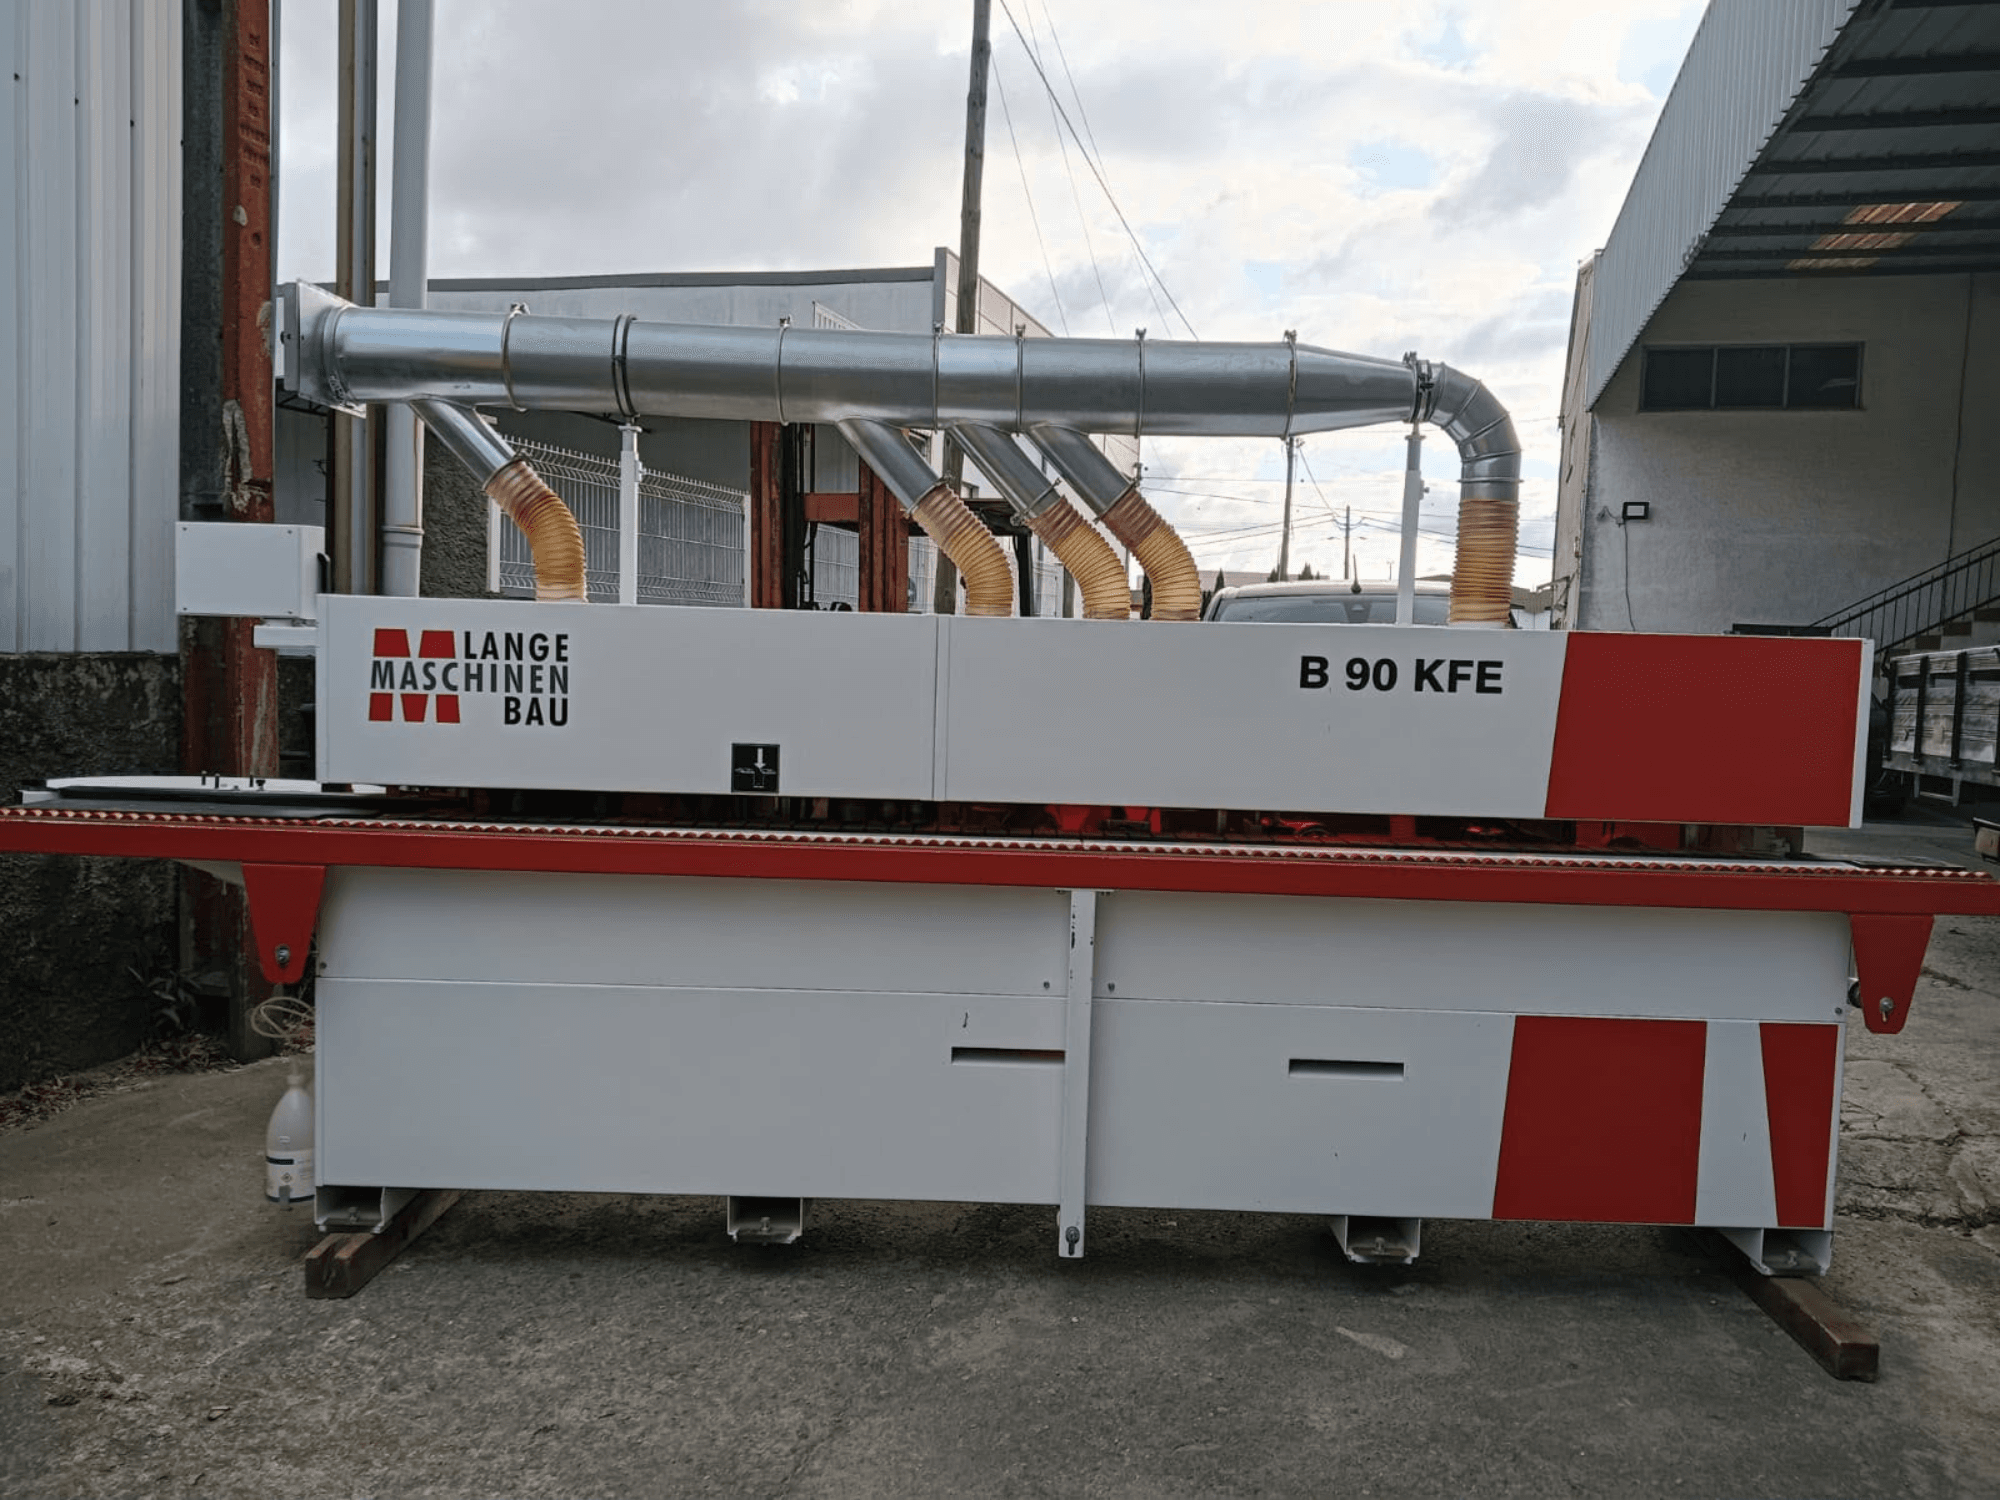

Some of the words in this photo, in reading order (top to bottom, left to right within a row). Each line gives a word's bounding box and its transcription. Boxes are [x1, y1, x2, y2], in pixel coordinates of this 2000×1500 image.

[464, 630, 569, 663] LANGE
[370, 660, 569, 695] MASCHINEN
[1299, 655, 1330, 690] B
[1345, 657, 1398, 692] 90
[1414, 658, 1504, 695] KFE
[504, 695, 569, 727] BAU
